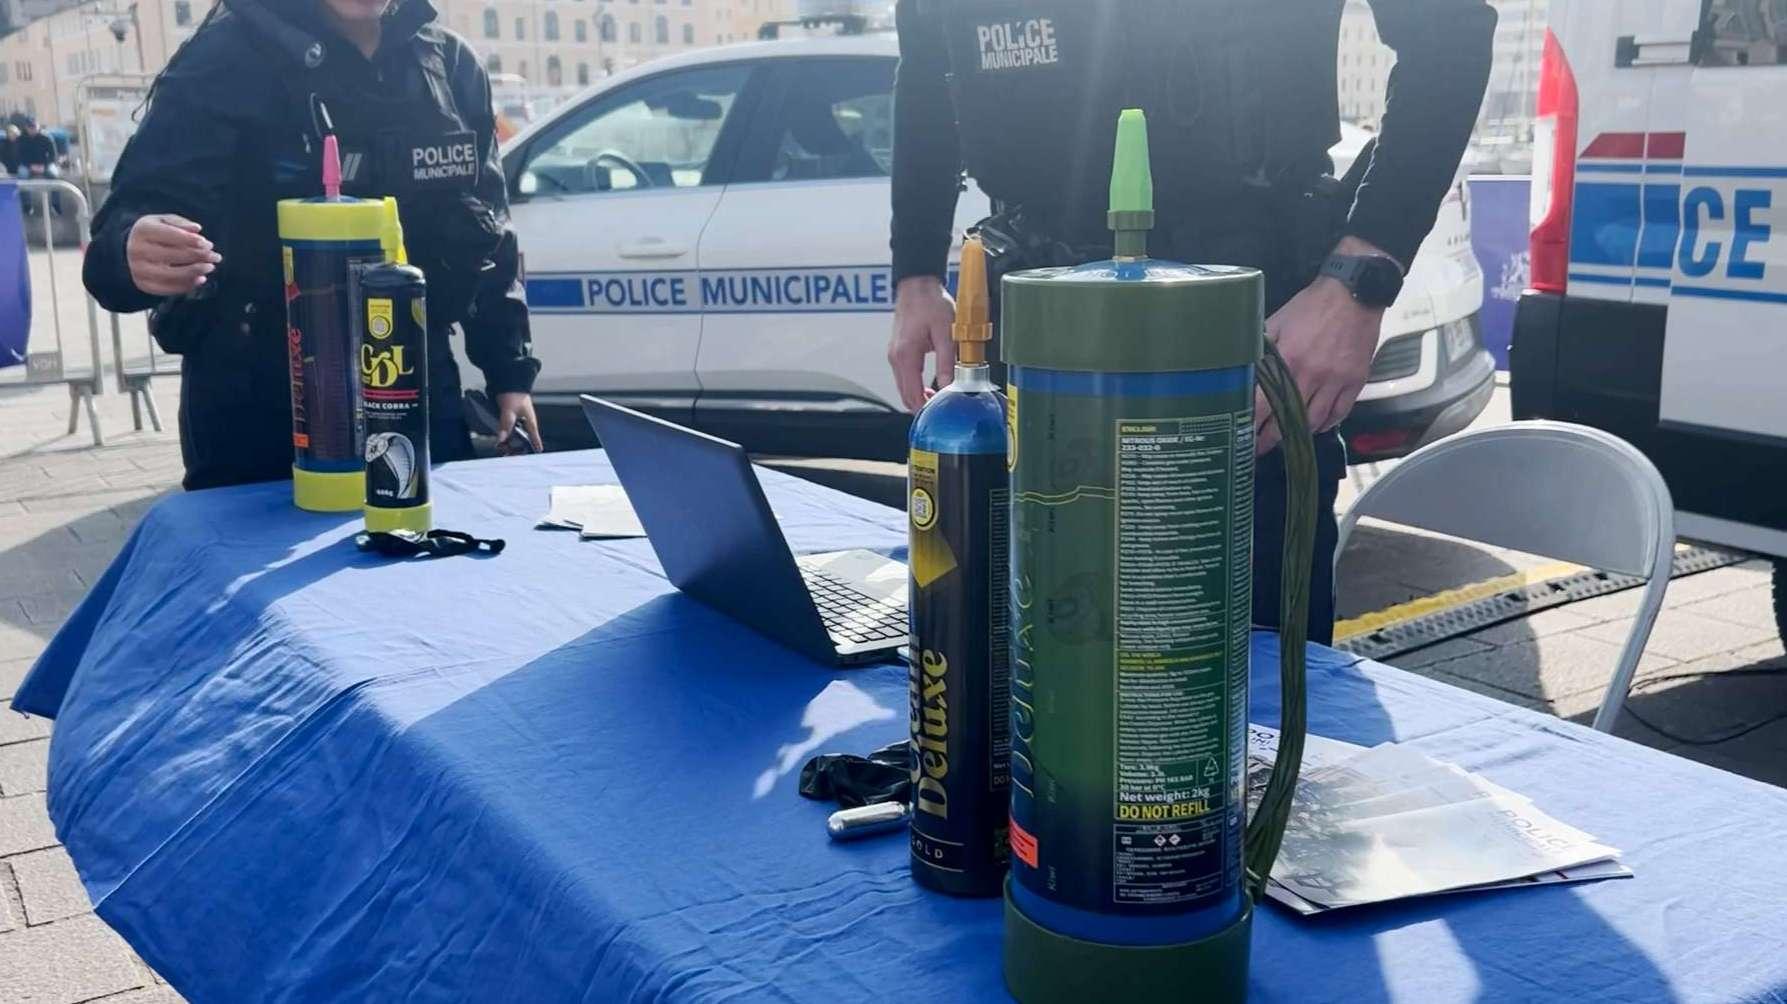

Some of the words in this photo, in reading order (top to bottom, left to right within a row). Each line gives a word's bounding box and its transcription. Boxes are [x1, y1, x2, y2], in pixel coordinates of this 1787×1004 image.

[977, 19, 1056, 51] POLICE
[981, 45, 1058, 70] MUNICIPALE
[412, 144, 474, 166] POLICE
[414, 163, 475, 179] MUNICIPALE
[587, 277, 685, 307] POLICE
[702, 273, 888, 306] MUNICIPALE
[916, 649, 948, 819] Deluxe
[1120, 792, 1143, 802] Net
[1144, 790, 1189, 803] weight:
[1191, 787, 1210, 799] 2kg
[1119, 804, 1140, 818] DO
[1142, 804, 1171, 818] NOT
[1172, 799, 1210, 817] REFILL
